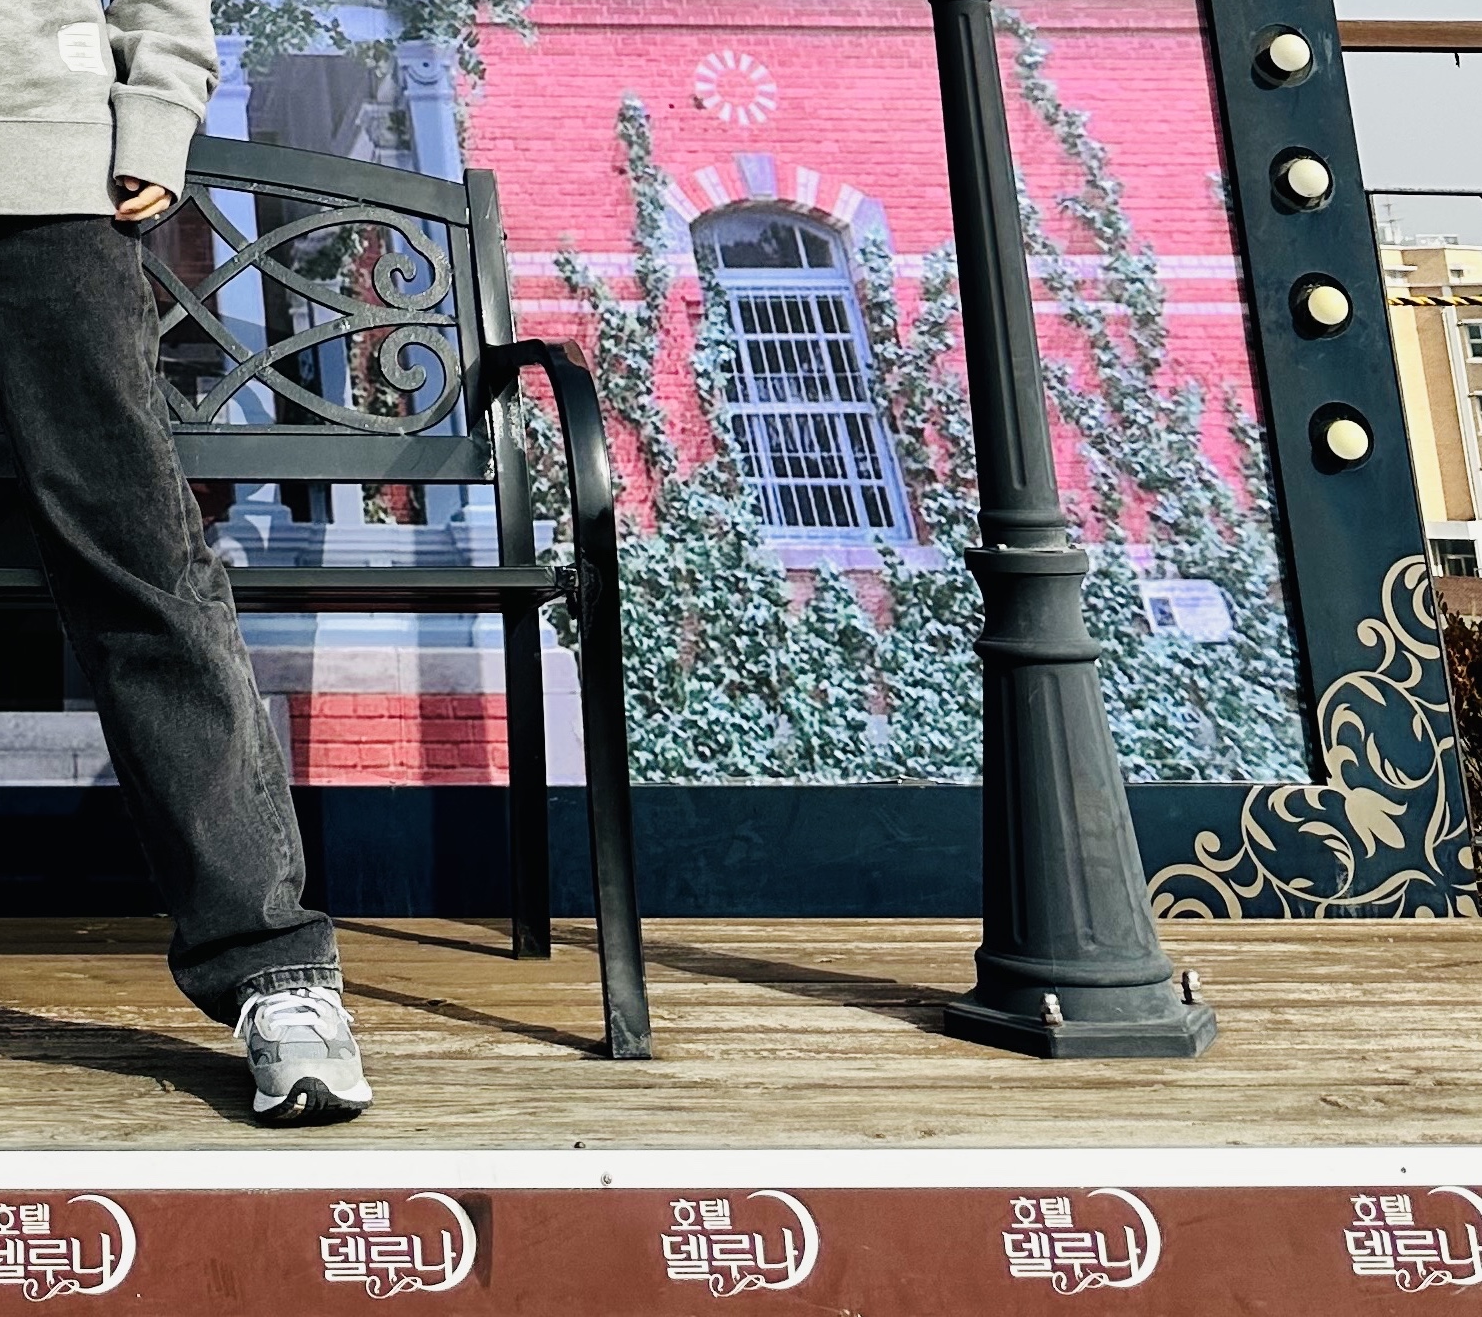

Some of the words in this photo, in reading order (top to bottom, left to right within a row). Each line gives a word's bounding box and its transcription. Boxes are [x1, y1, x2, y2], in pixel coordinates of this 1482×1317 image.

[329, 1201, 391, 1232] 호텔
[670, 1199, 732, 1231] 호텔
[1010, 1197, 1074, 1228] 호텔
[1350, 1194, 1415, 1226] 호텔
[320, 1230, 476, 1298] 델루나
[661, 1227, 818, 1297] 델루나
[1002, 1225, 1160, 1295] 델루나
